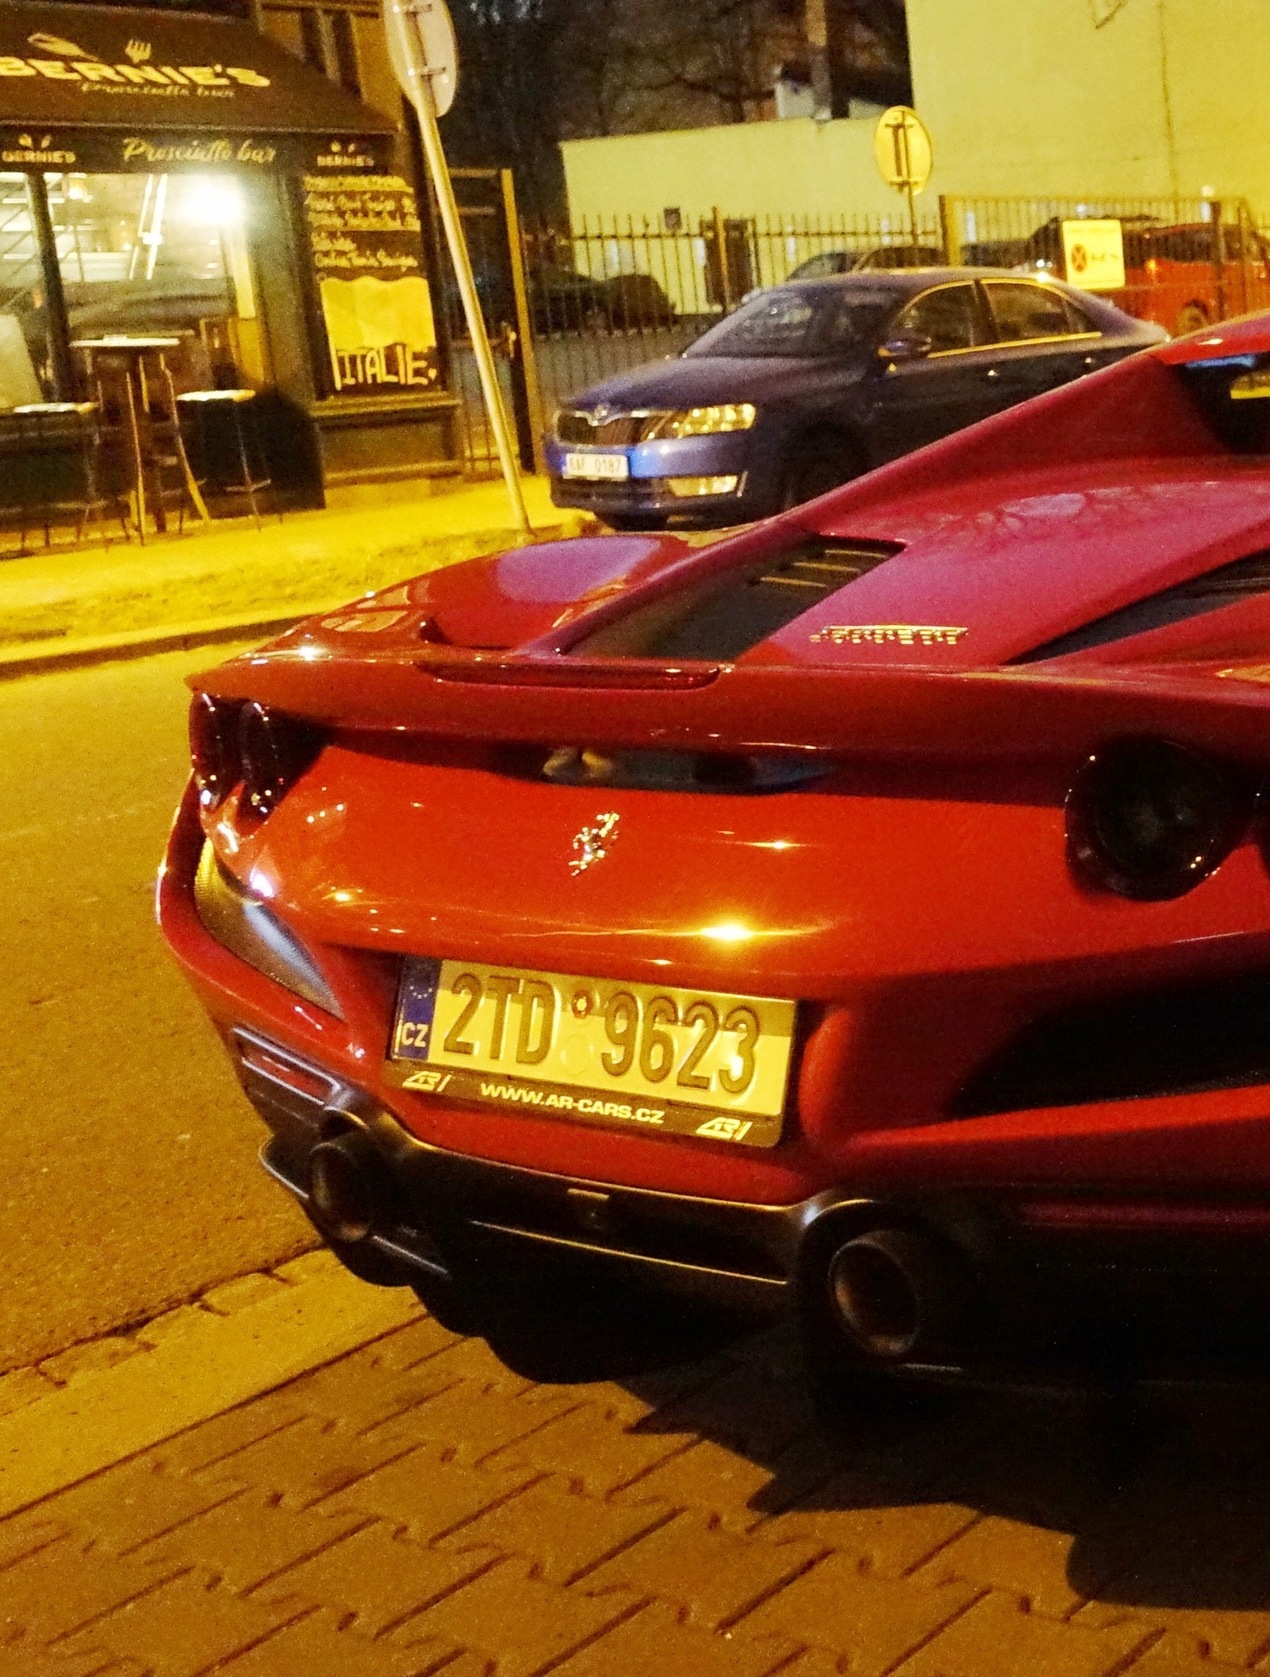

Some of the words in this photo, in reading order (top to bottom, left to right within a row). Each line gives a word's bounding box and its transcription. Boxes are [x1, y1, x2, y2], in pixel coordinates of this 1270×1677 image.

[0, 56, 271, 87] BERNIE'S
[123, 137, 231, 162] Prosciutto
[237, 138, 276, 163] bar
[402, 1022, 428, 1047] CZ
[444, 972, 556, 1065] 2TD
[601, 992, 760, 1094] 9623
[481, 1083, 665, 1124] WWW.AR-CARS.CZ
